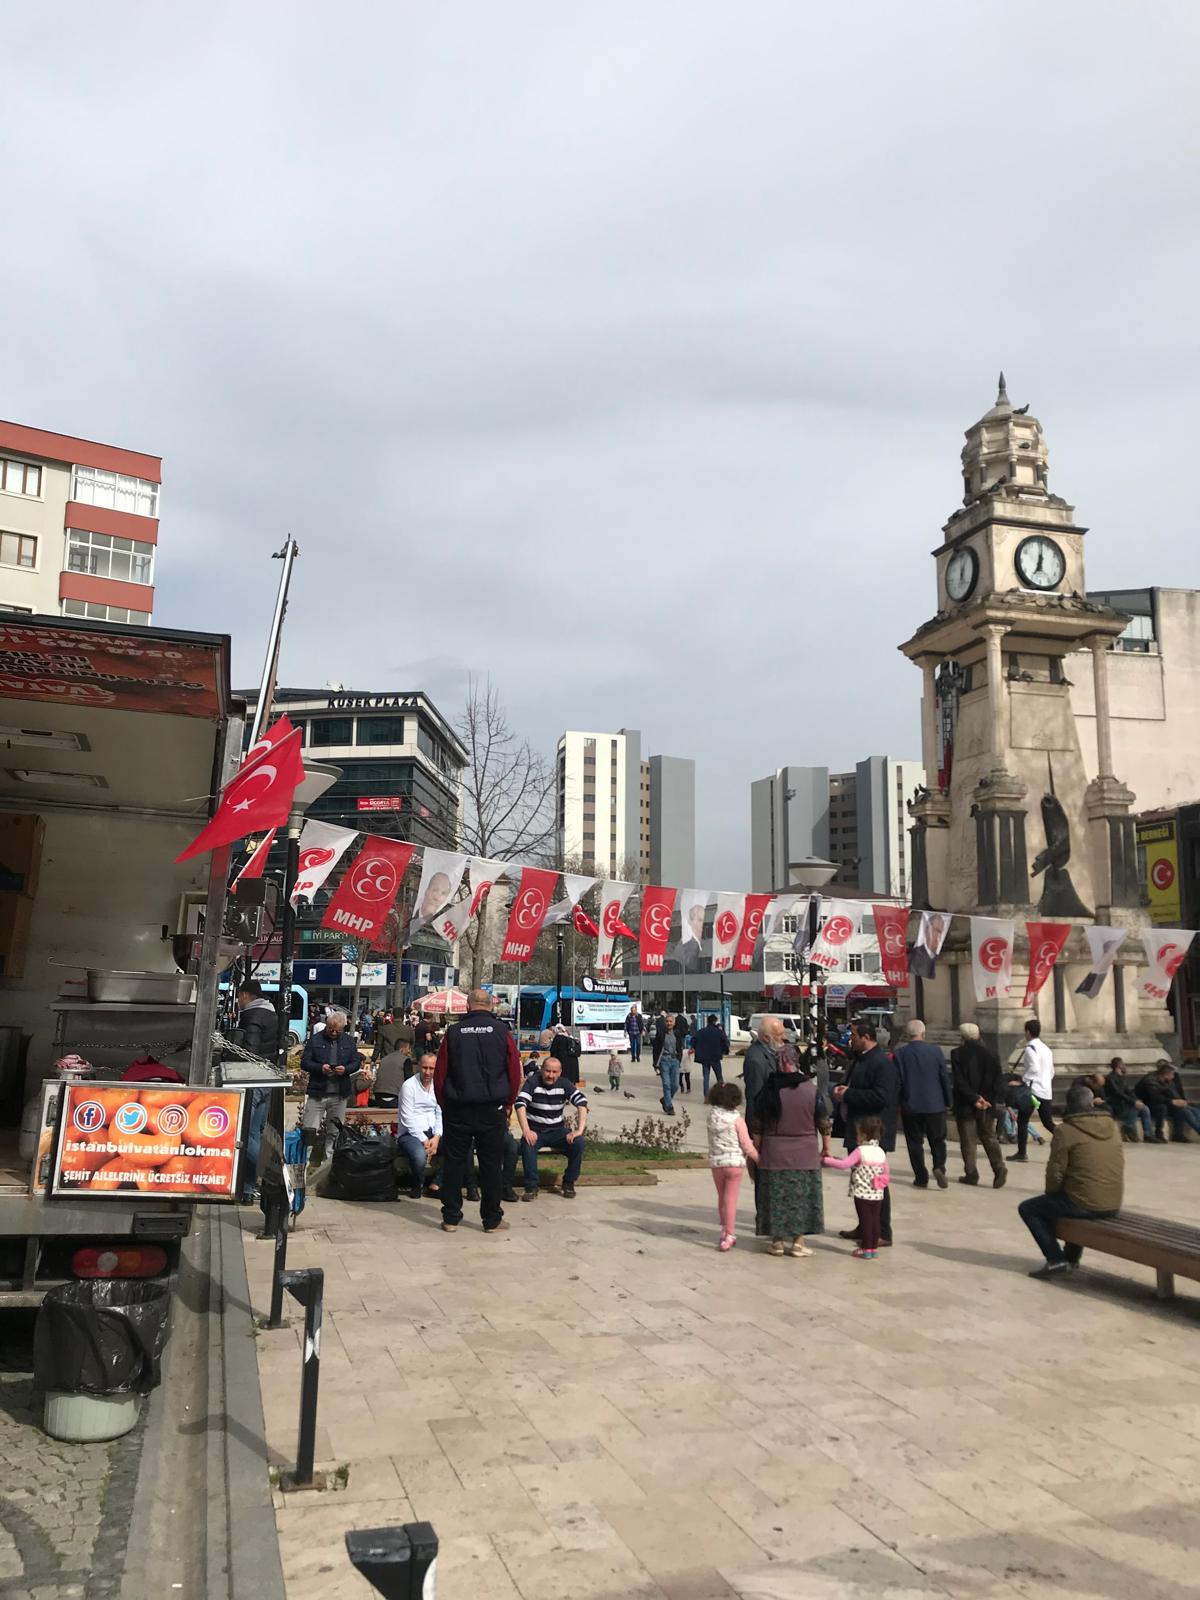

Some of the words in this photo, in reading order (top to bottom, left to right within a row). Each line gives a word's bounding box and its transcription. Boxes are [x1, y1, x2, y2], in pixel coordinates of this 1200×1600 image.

[0, 680, 91, 696] VATA
[375, 695, 419, 707] PLAZA
[332, 908, 375, 933] MHP
[504, 942, 531, 958] MHP
[810, 952, 840, 970] MHP
[66, 1140, 232, 1158] istanbulvatanlokma
[63, 1168, 91, 1183] ŞEHİT
[91, 1168, 146, 1183] AİLELERİNE
[147, 1170, 191, 1184] ÜCRETSİZ
[192, 1171, 227, 1185] HİZMET
